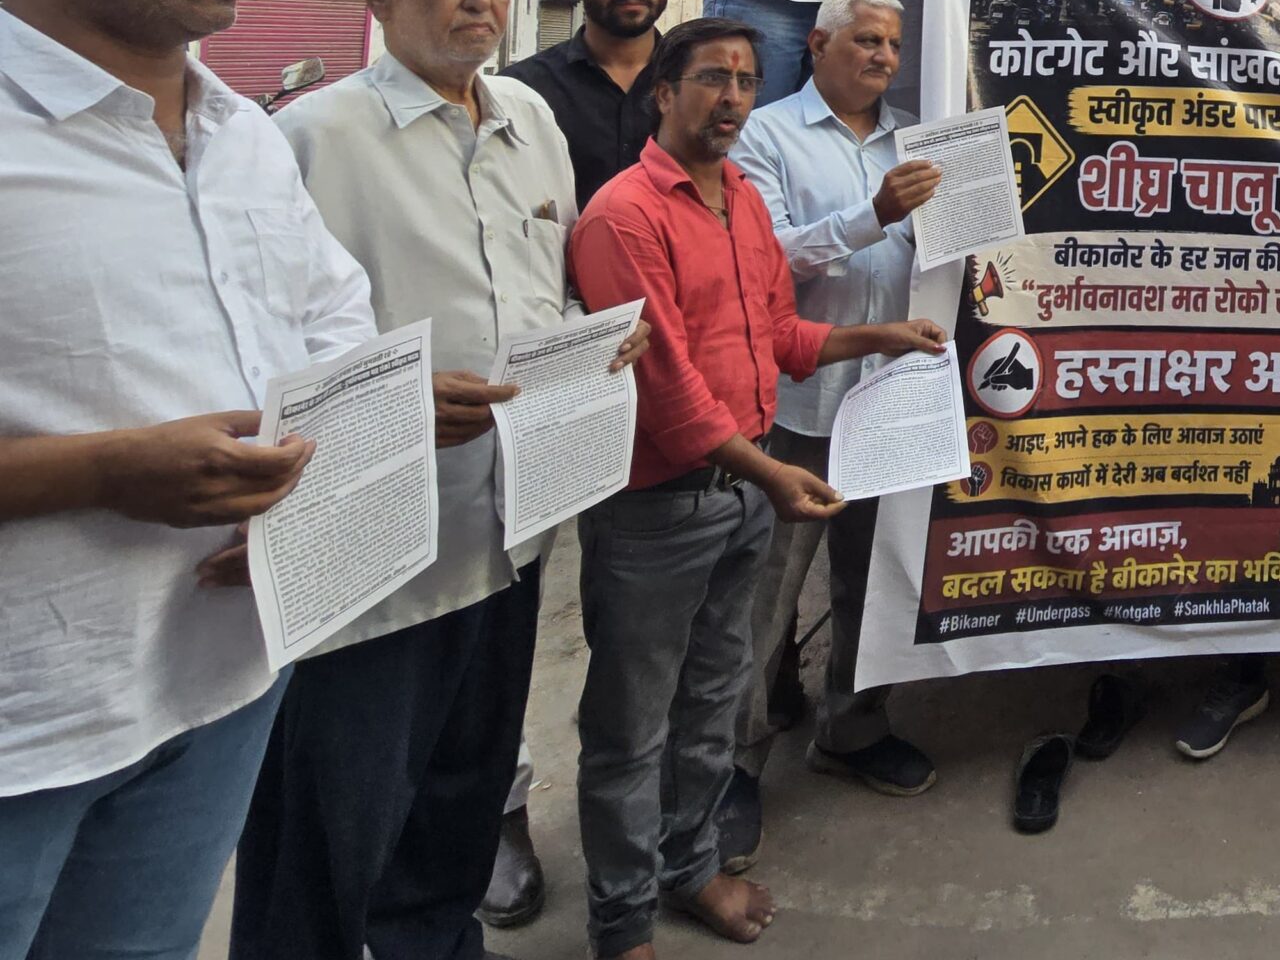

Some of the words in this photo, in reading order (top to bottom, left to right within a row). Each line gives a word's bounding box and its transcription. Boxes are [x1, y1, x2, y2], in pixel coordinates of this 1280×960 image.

[988, 29, 1107, 77] कोटगेट
[1118, 30, 1183, 78] और
[1088, 88, 1176, 135] स्वीकृत
[1181, 92, 1236, 128] अंडर
[1078, 141, 1177, 217] शीघ्र
[1054, 237, 1144, 269] बीकानेर
[1150, 239, 1174, 269] के
[1180, 246, 1207, 271] हर
[1213, 247, 1249, 270] जन
[1172, 289, 1210, 314] मत
[1215, 280, 1269, 315] रोको
[1054, 348, 1237, 400] हस्ताक्षर
[1054, 425, 1087, 449] अपने
[1092, 428, 1119, 448] हक
[1122, 423, 1139, 446] के
[1142, 422, 1173, 446] लिए
[1178, 426, 1225, 446] आवाज
[1229, 422, 1265, 447] उठाएं
[1001, 464, 1051, 492] विकास
[1095, 461, 1109, 484] में
[1112, 460, 1136, 486] देरी
[1141, 466, 1166, 483] अब
[1223, 460, 1251, 486] नहीं
[947, 519, 1039, 557] आपकी
[1046, 526, 1092, 555] एक
[942, 570, 1007, 600] बदल
[1010, 564, 1085, 593] सकता
[1090, 560, 1110, 595] है
[1112, 553, 1202, 589] बीकानेर
[1205, 559, 1238, 584] का
[939, 613, 1001, 634] #Bikaner
[1015, 604, 1091, 624] #Underpass
[1104, 603, 1161, 623] #Kotgate
[1174, 597, 1270, 617] #SankhlaPhatak
